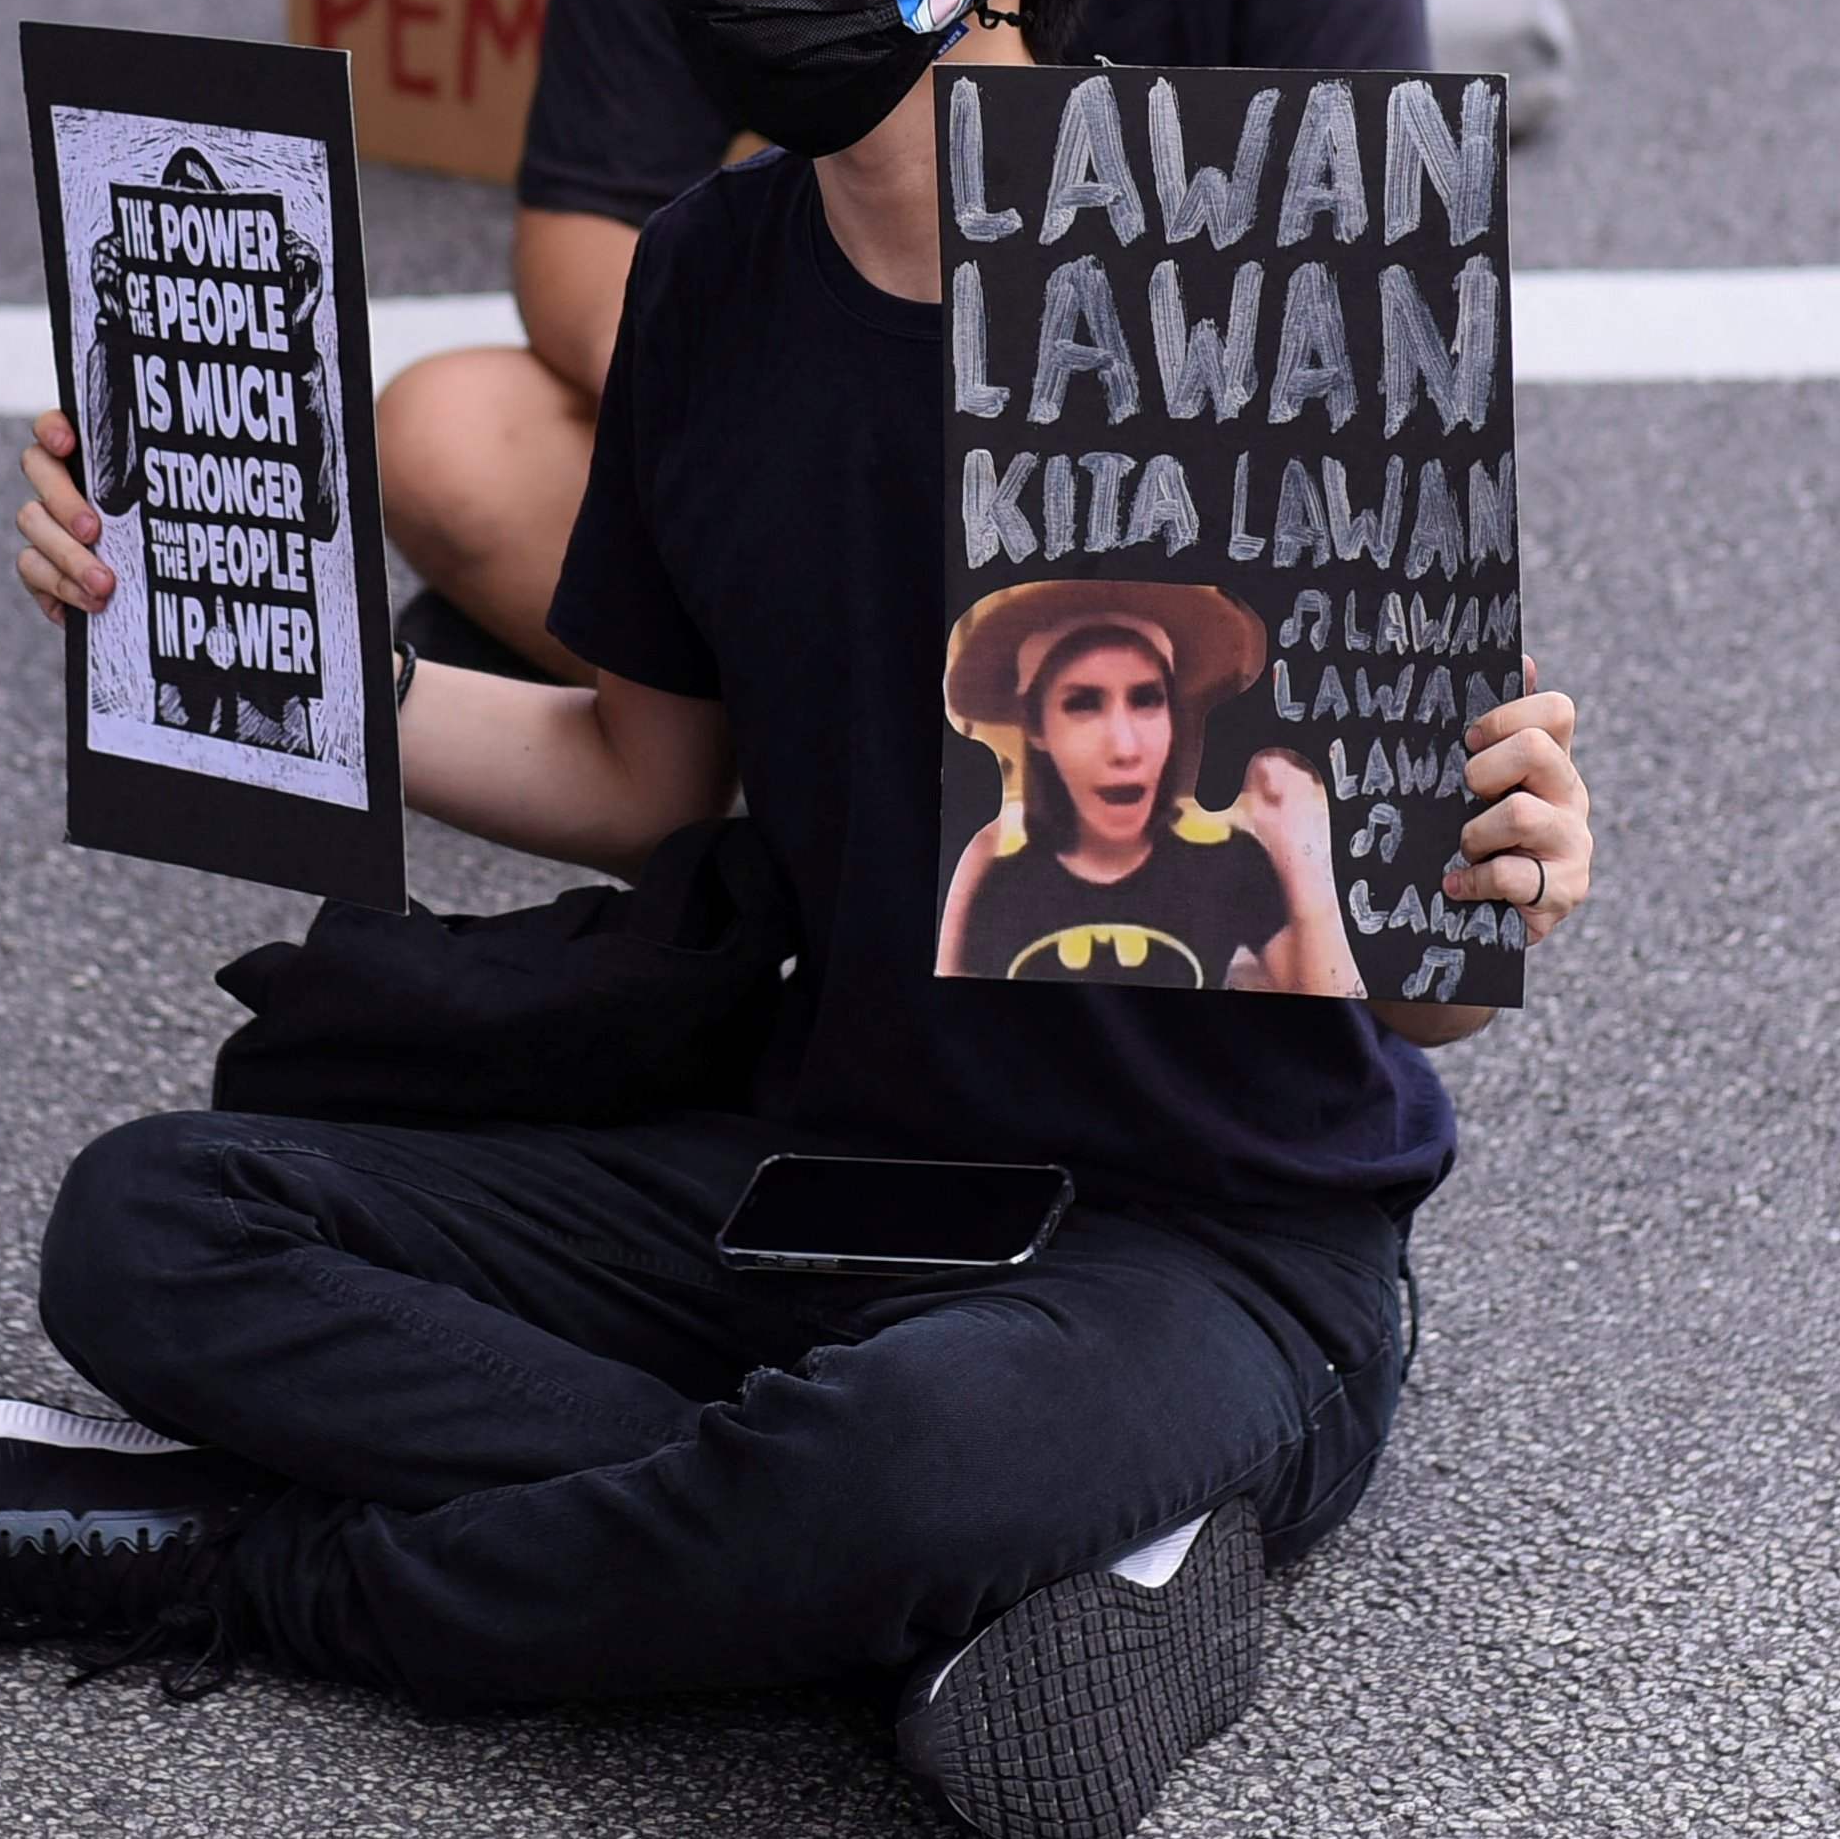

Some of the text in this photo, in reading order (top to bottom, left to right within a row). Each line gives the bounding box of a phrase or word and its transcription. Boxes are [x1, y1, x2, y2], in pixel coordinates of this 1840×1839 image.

[948, 74, 1502, 249] LAWAN
[118, 197, 281, 272] THE POWER
[125, 271, 289, 352] OF THE PEOPLE
[949, 253, 1501, 440] LAWAN
[133, 354, 297, 446] IS MUCH
[144, 446, 305, 522] STRONGER
[961, 448, 1515, 579] KITA LAWAN
[149, 518, 307, 592] THAN THE PEOPLE
[155, 590, 181, 658] IN
[1345, 589, 1517, 657] LAWAN
